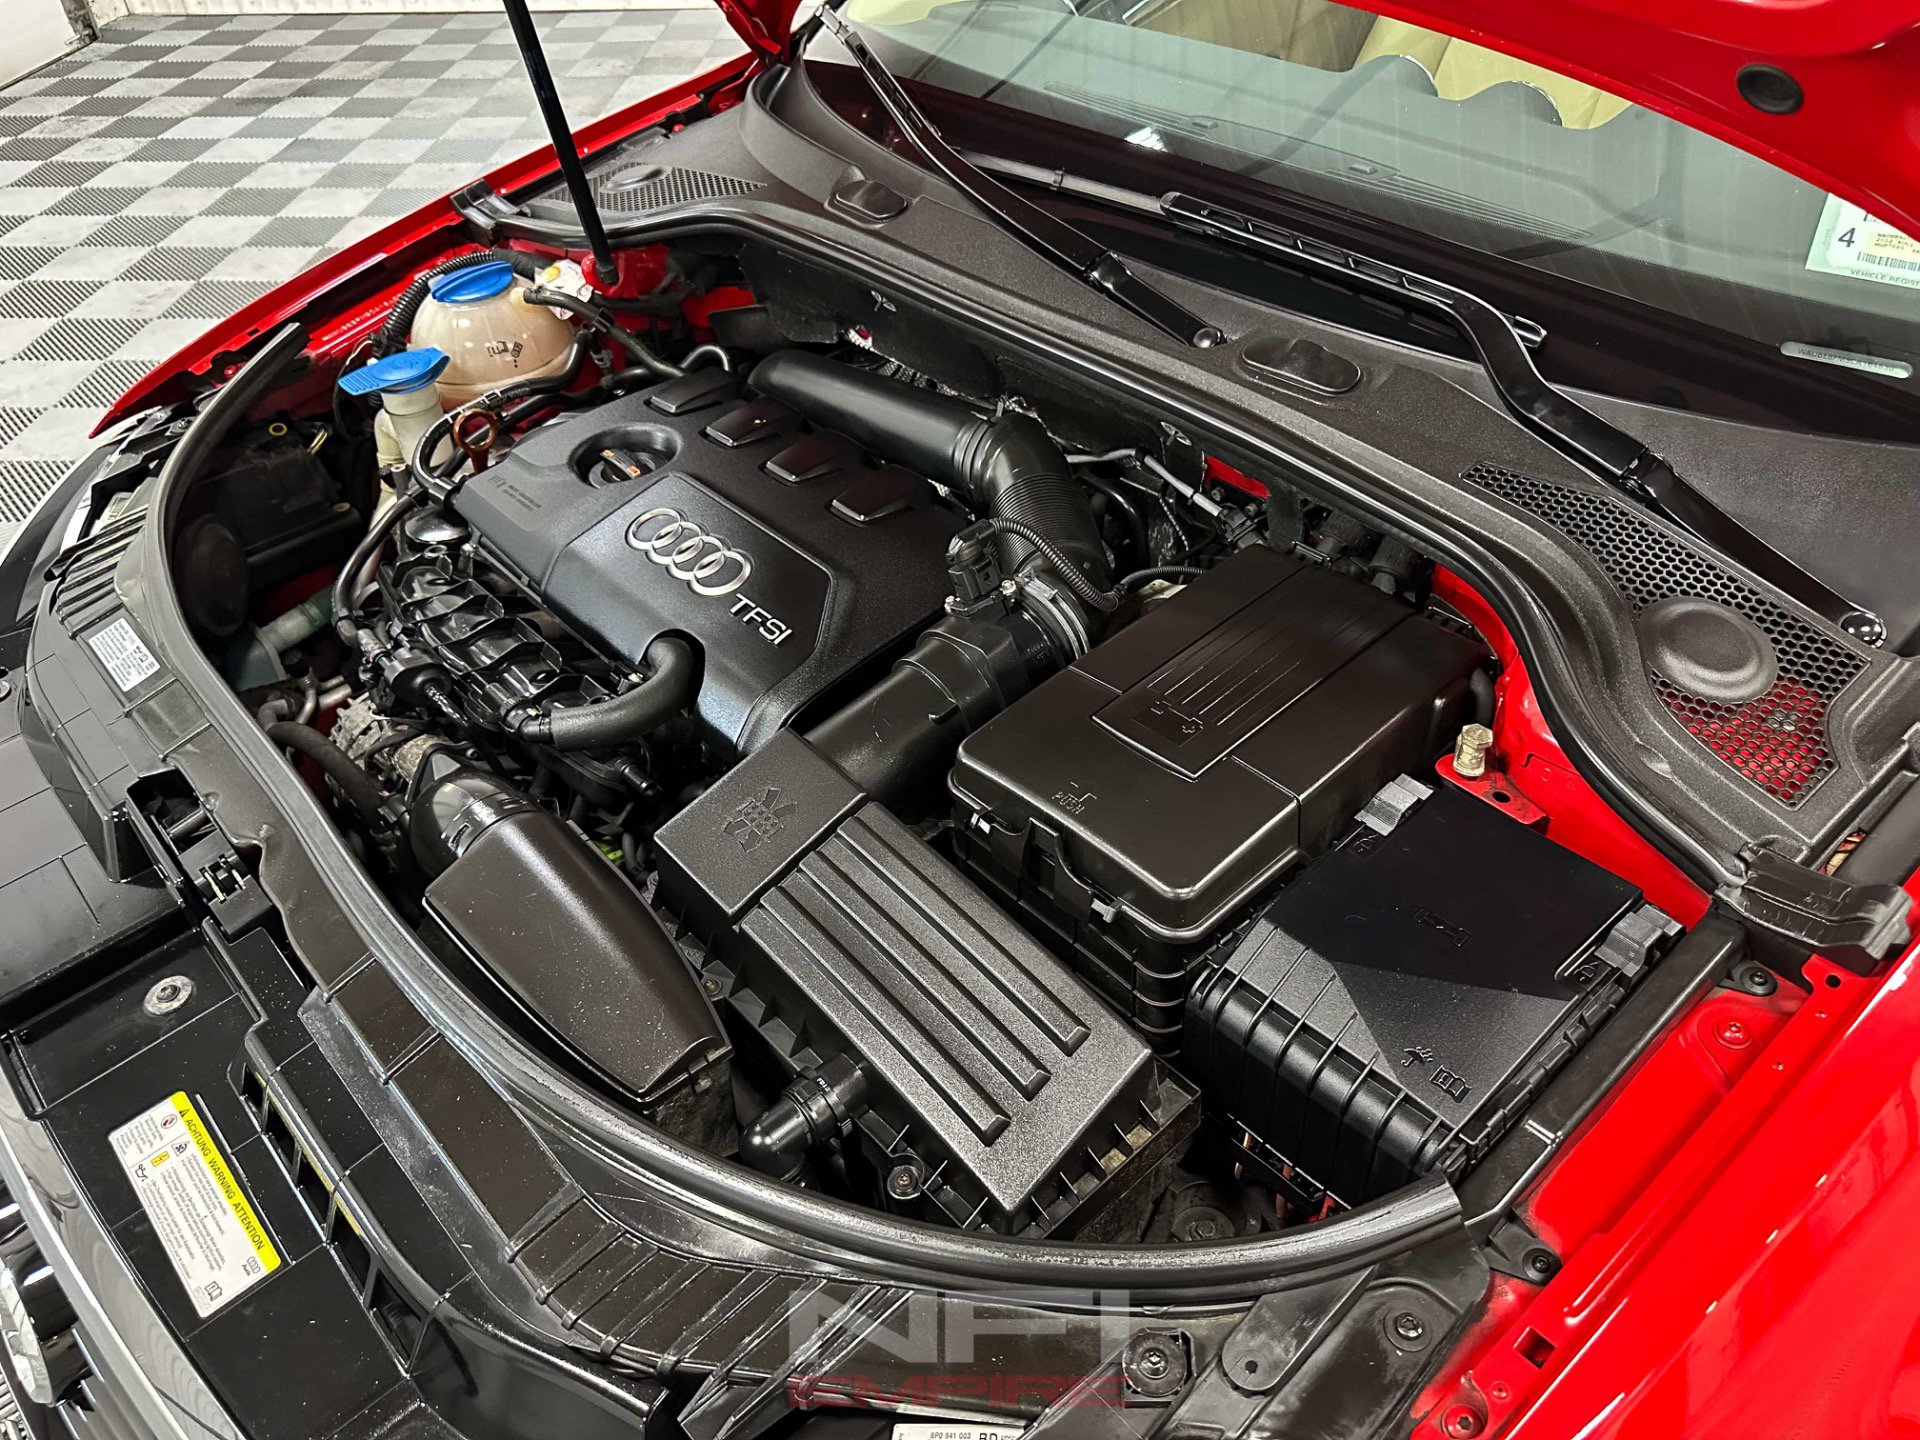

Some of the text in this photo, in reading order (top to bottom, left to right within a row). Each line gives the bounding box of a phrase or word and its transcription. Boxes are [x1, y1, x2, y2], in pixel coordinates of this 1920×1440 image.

[1838, 227, 1856, 248] 4
[1850, 268, 1886, 280] VEHICLE
[730, 593, 793, 645] TFSI
[185, 1118, 210, 1157] ACHTUNG
[208, 1158, 235, 1200] WARNING
[232, 1201, 265, 1250] ATTENTION
[945, 1432, 956, 1440] 941
[959, 1432, 971, 1440] 003
